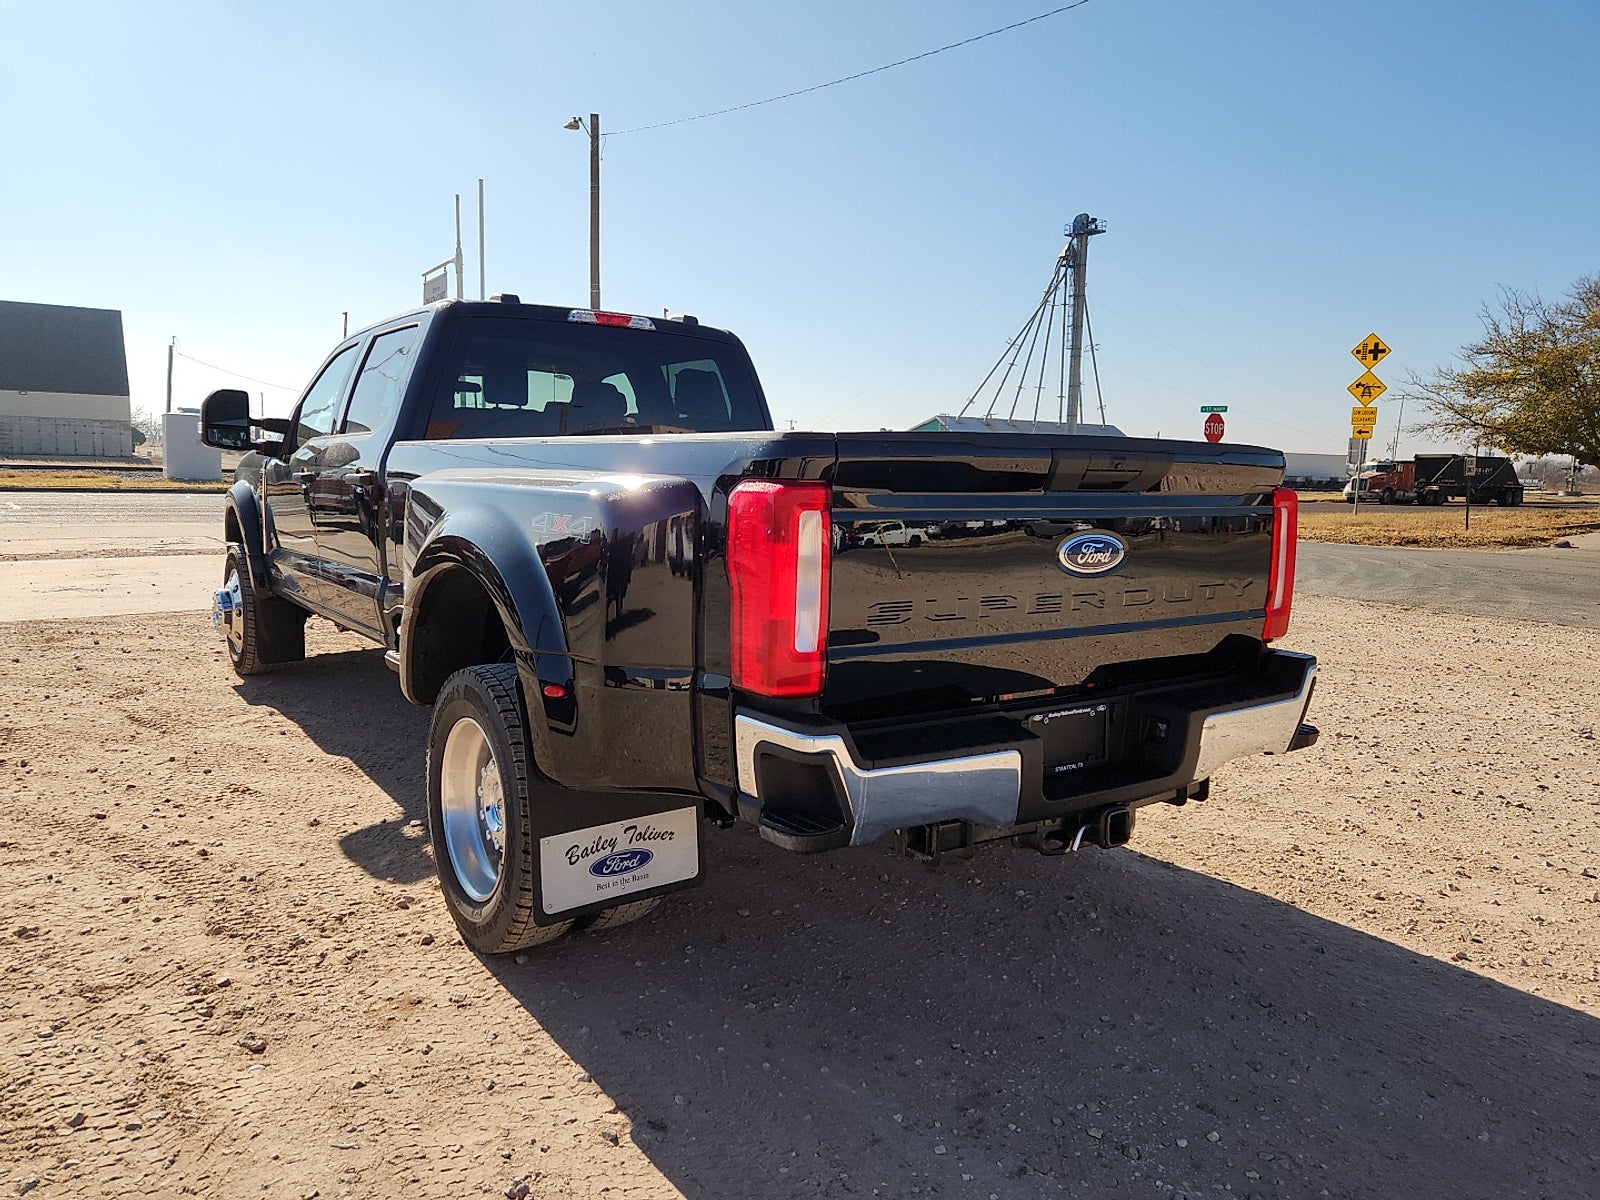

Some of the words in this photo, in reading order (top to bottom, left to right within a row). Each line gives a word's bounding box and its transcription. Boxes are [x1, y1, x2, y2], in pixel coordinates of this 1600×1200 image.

[1205, 422, 1224, 435] STOP
[1077, 542, 1113, 565] Ford
[866, 592, 1106, 626] SUPER
[1122, 578, 1254, 607] DUTY
[565, 835, 618, 866] Bailey
[623, 825, 675, 845] Toliver
[602, 853, 641, 874] Ford
[596, 882, 610, 891] Best
[619, 877, 630, 885] the
